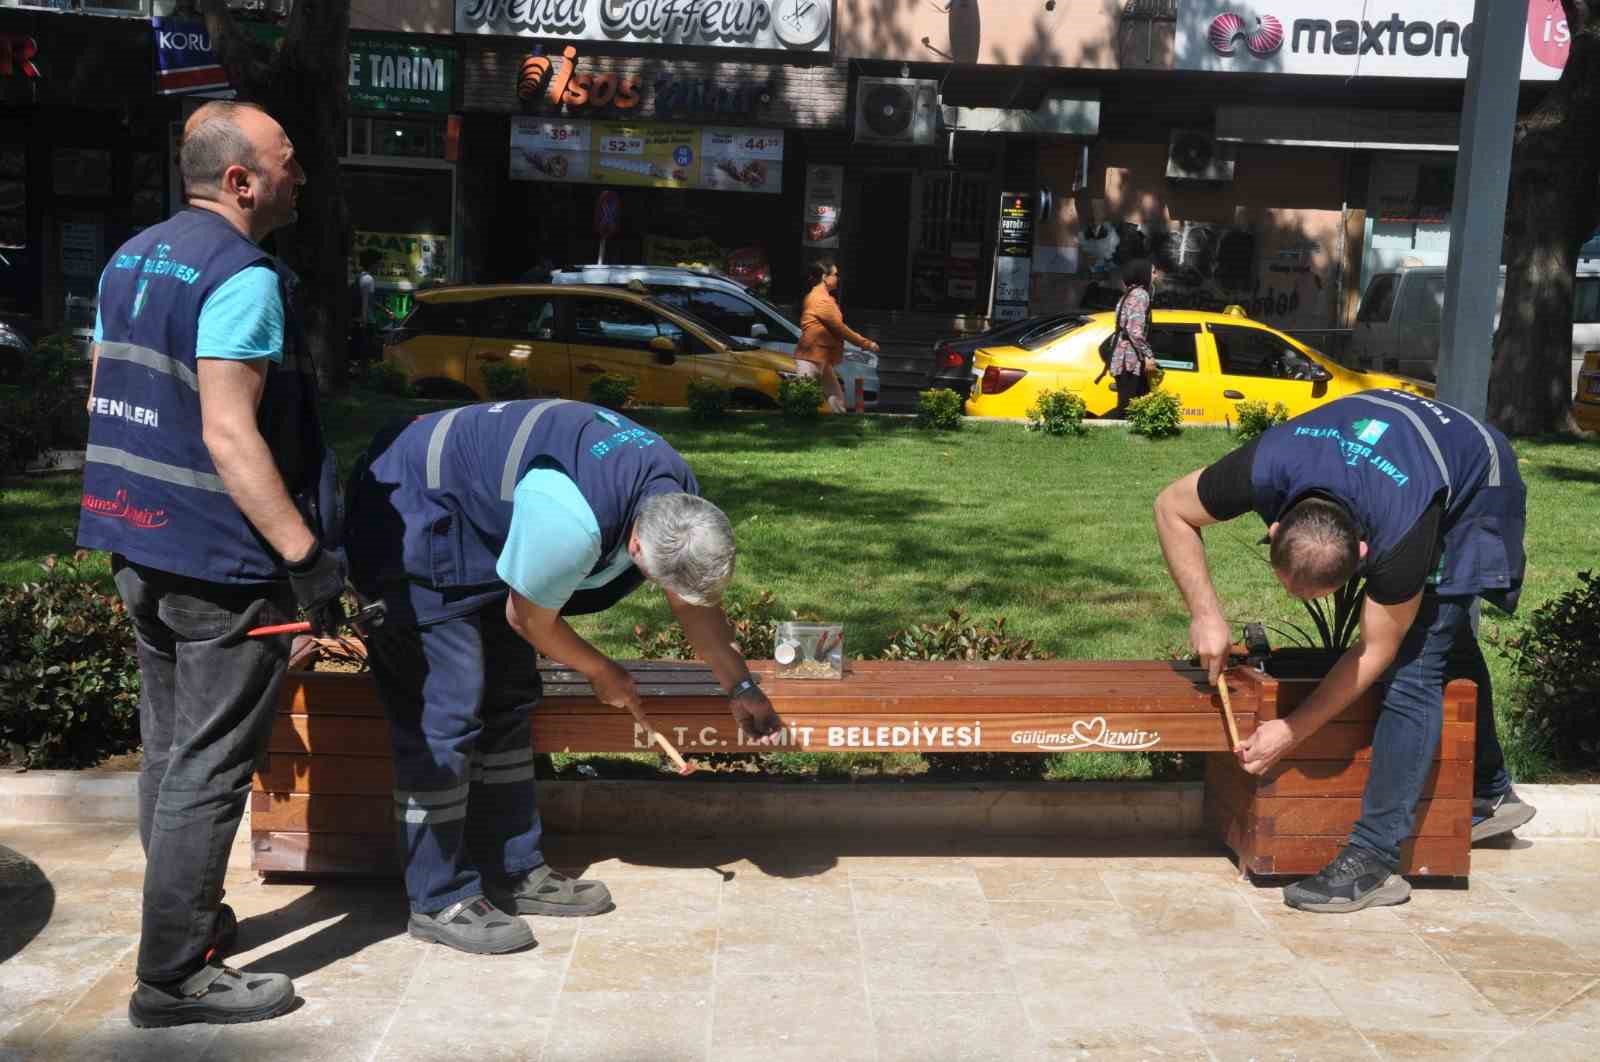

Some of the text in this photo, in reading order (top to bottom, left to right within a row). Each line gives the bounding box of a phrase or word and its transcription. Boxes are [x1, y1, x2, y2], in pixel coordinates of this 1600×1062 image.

[159, 31, 213, 52] KORU
[367, 53, 446, 92] TARIM
[672, 726, 728, 747] T.C.
[827, 720, 983, 748] BELEDİYESİ
[1010, 729, 1076, 745] Gülümse
